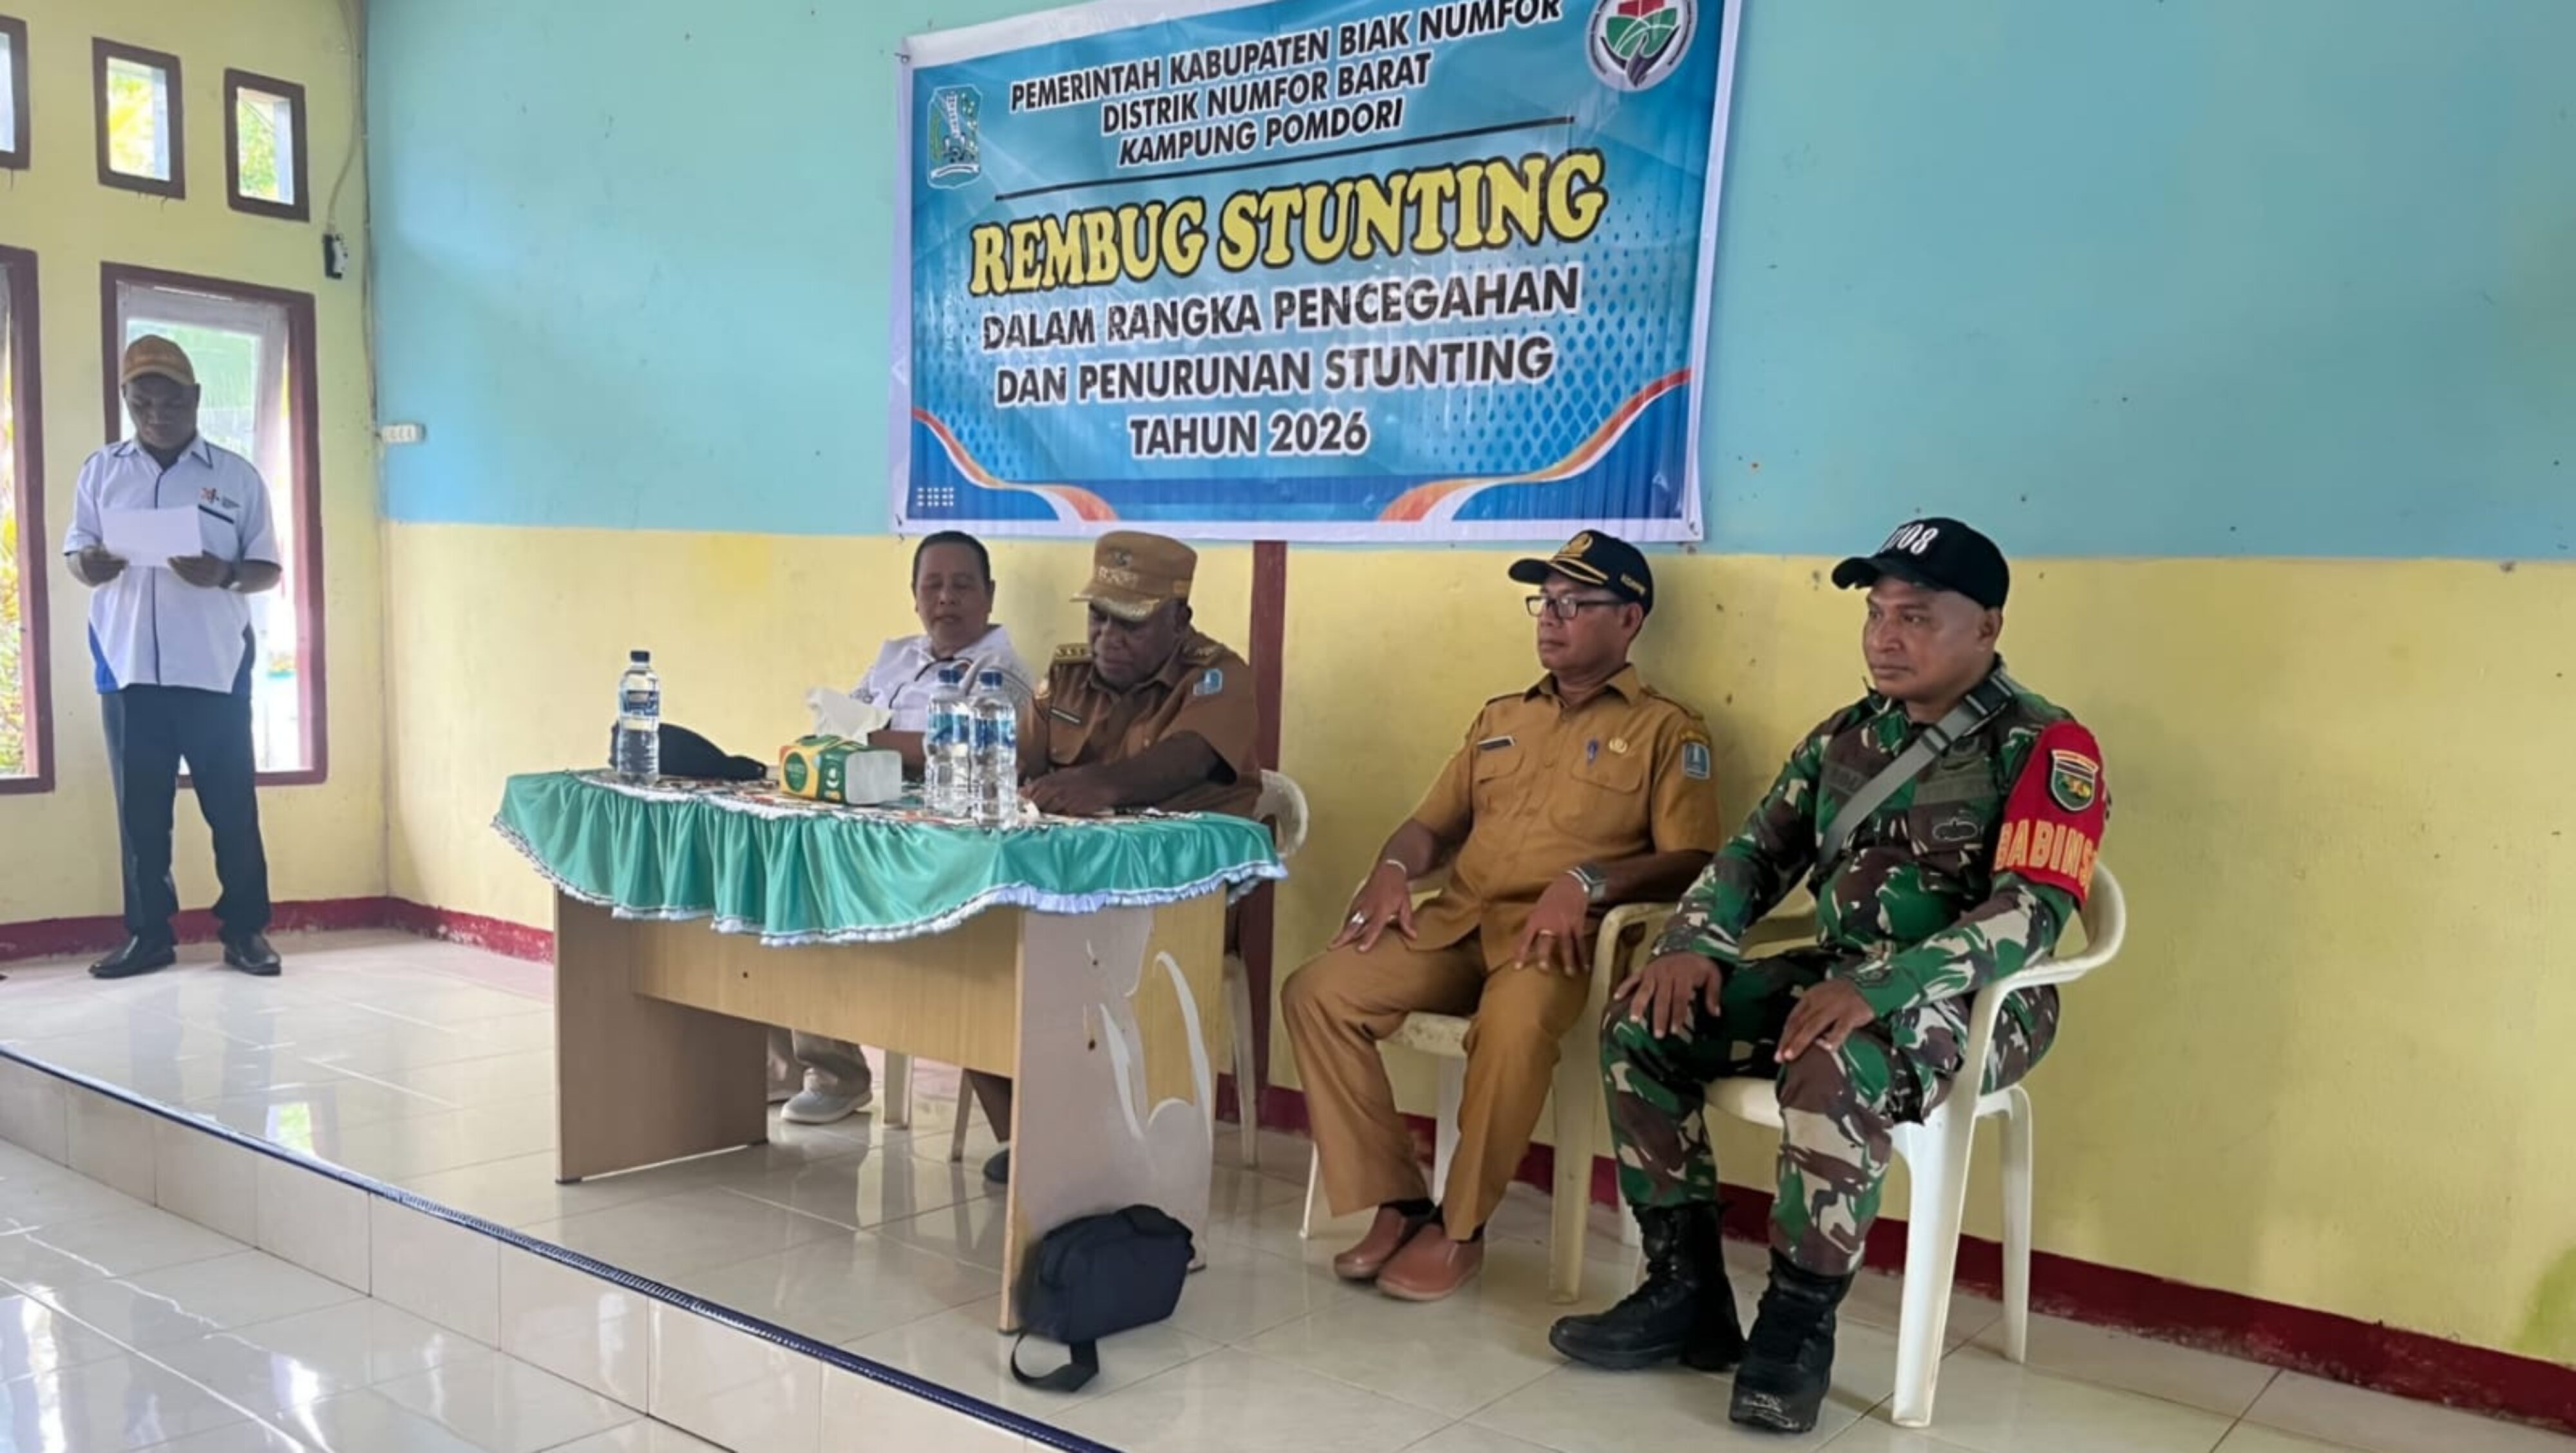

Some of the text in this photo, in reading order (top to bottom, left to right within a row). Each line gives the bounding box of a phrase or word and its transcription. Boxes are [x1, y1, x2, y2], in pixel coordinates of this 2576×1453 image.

[1012, 0, 1559, 110] PEMERINTAH KABUPATEN BIAK NUMFOR
[1103, 53, 1431, 132] DISTRIK NUMFOR BARAT
[1119, 99, 1403, 165] KAMPUNG POMDORI
[970, 149, 1607, 295] REMBUG STUNTING
[983, 267, 1579, 350] DALAM RANGKA PENCEGAHAN
[997, 337, 1553, 403] DAN PENURUNAN STUNTING
[1131, 411, 1367, 455] TAHUN 2026
